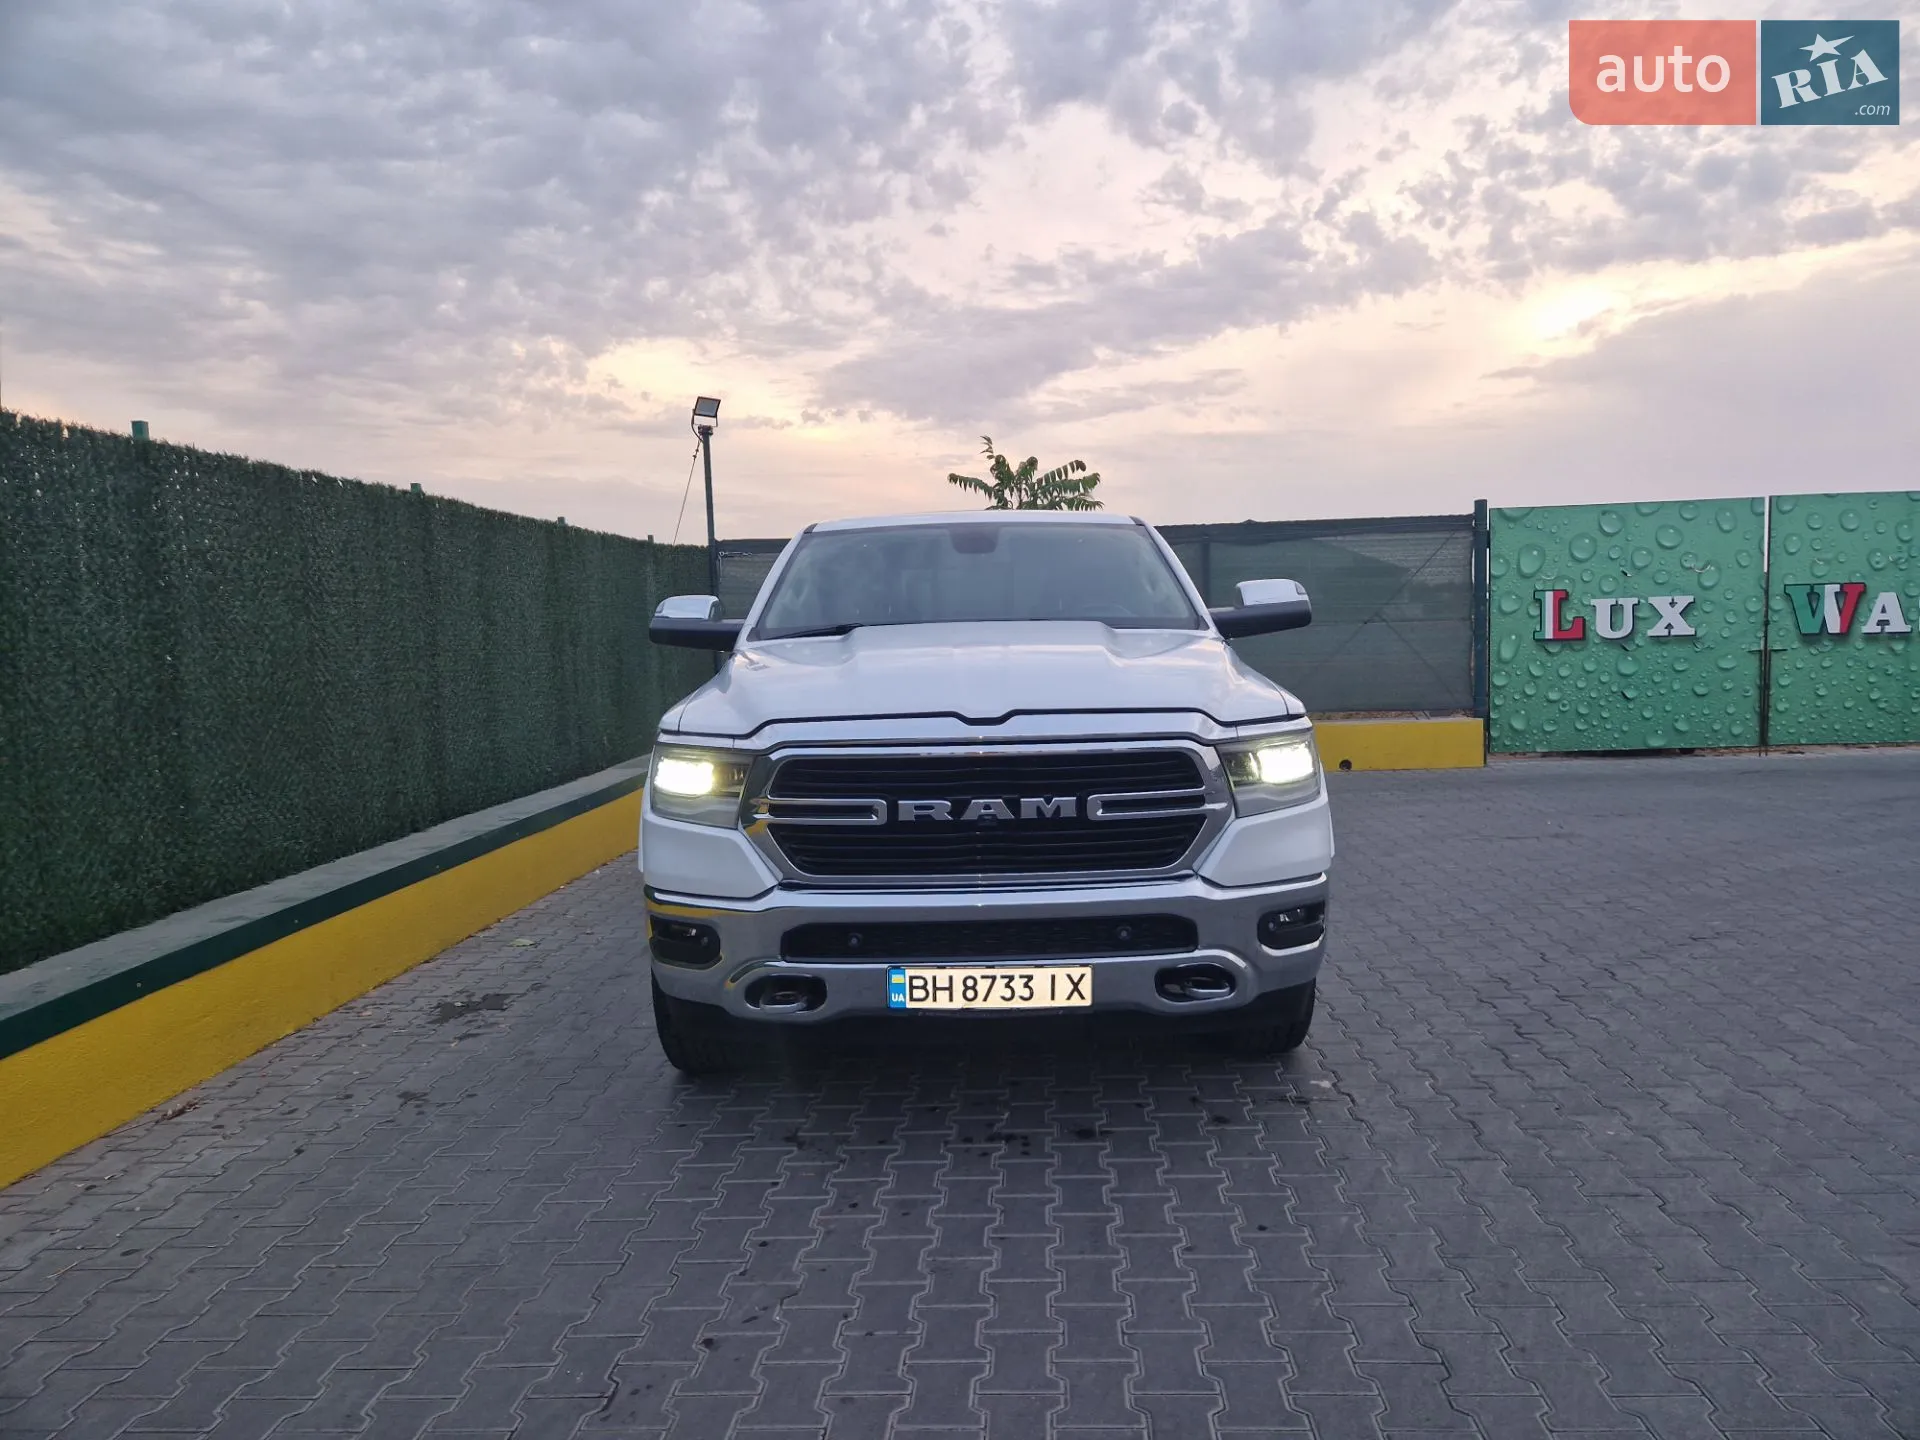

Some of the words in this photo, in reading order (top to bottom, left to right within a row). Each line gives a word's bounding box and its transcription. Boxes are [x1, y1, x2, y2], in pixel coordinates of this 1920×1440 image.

[1784, 582, 1920, 636] WA
[897, 797, 1078, 821] RAM
[892, 993, 904, 1002] UA
[908, 975, 954, 1003] BH
[961, 974, 1035, 1002] 8733
[1049, 973, 1087, 1001] IX
